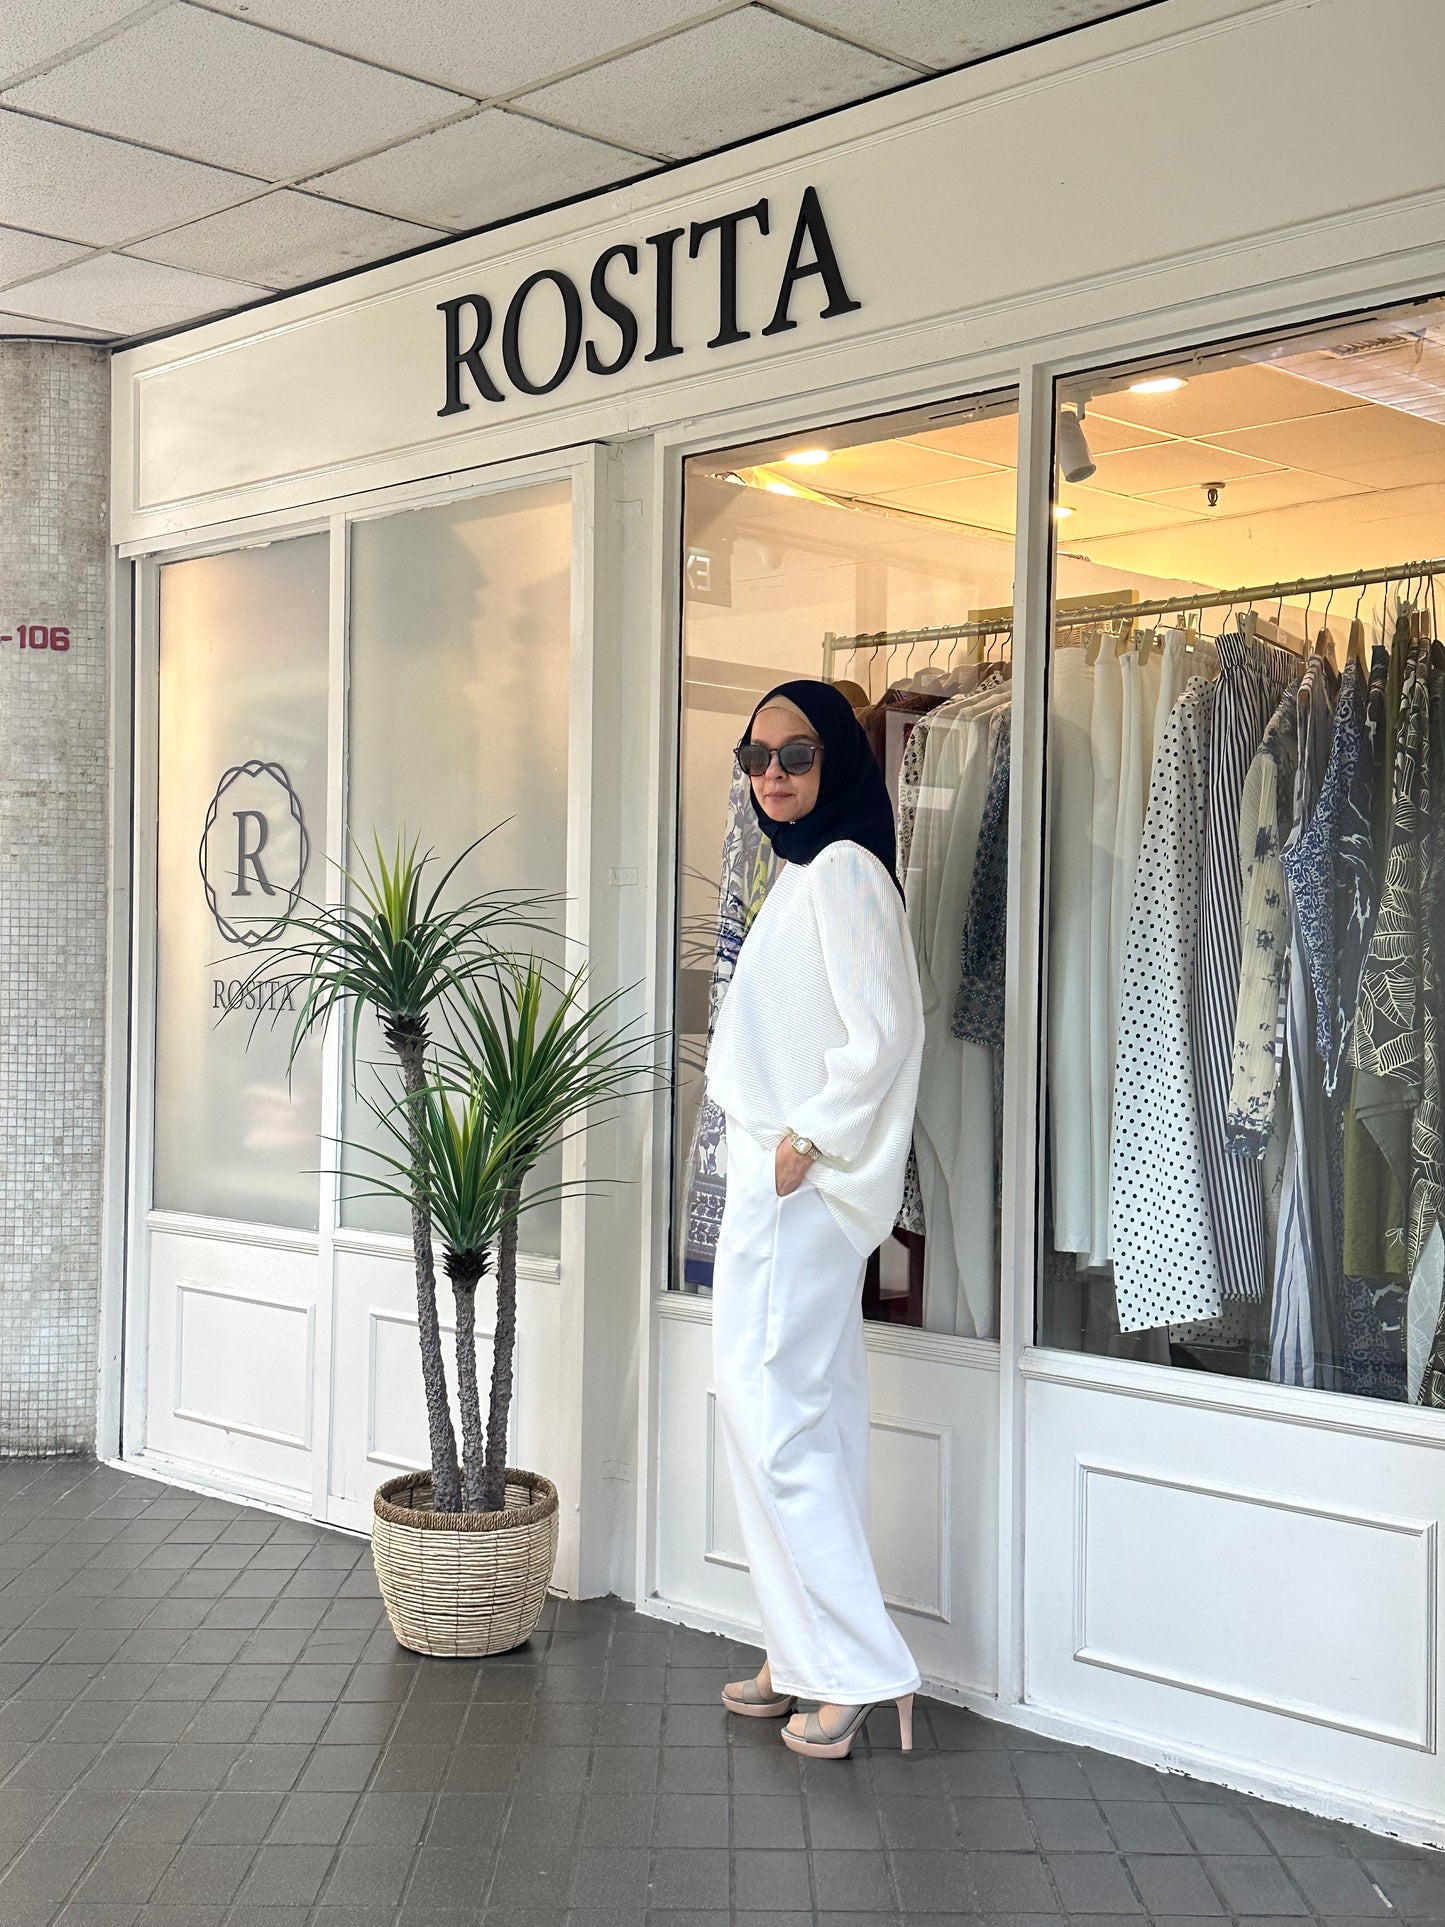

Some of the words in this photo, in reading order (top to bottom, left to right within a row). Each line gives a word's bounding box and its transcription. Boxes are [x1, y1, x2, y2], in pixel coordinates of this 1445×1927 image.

[437, 186, 861, 417] ROSITA
[0, 624, 70, 651] -106
[231, 810, 275, 896] R
[213, 979, 295, 1011] ROSITA
